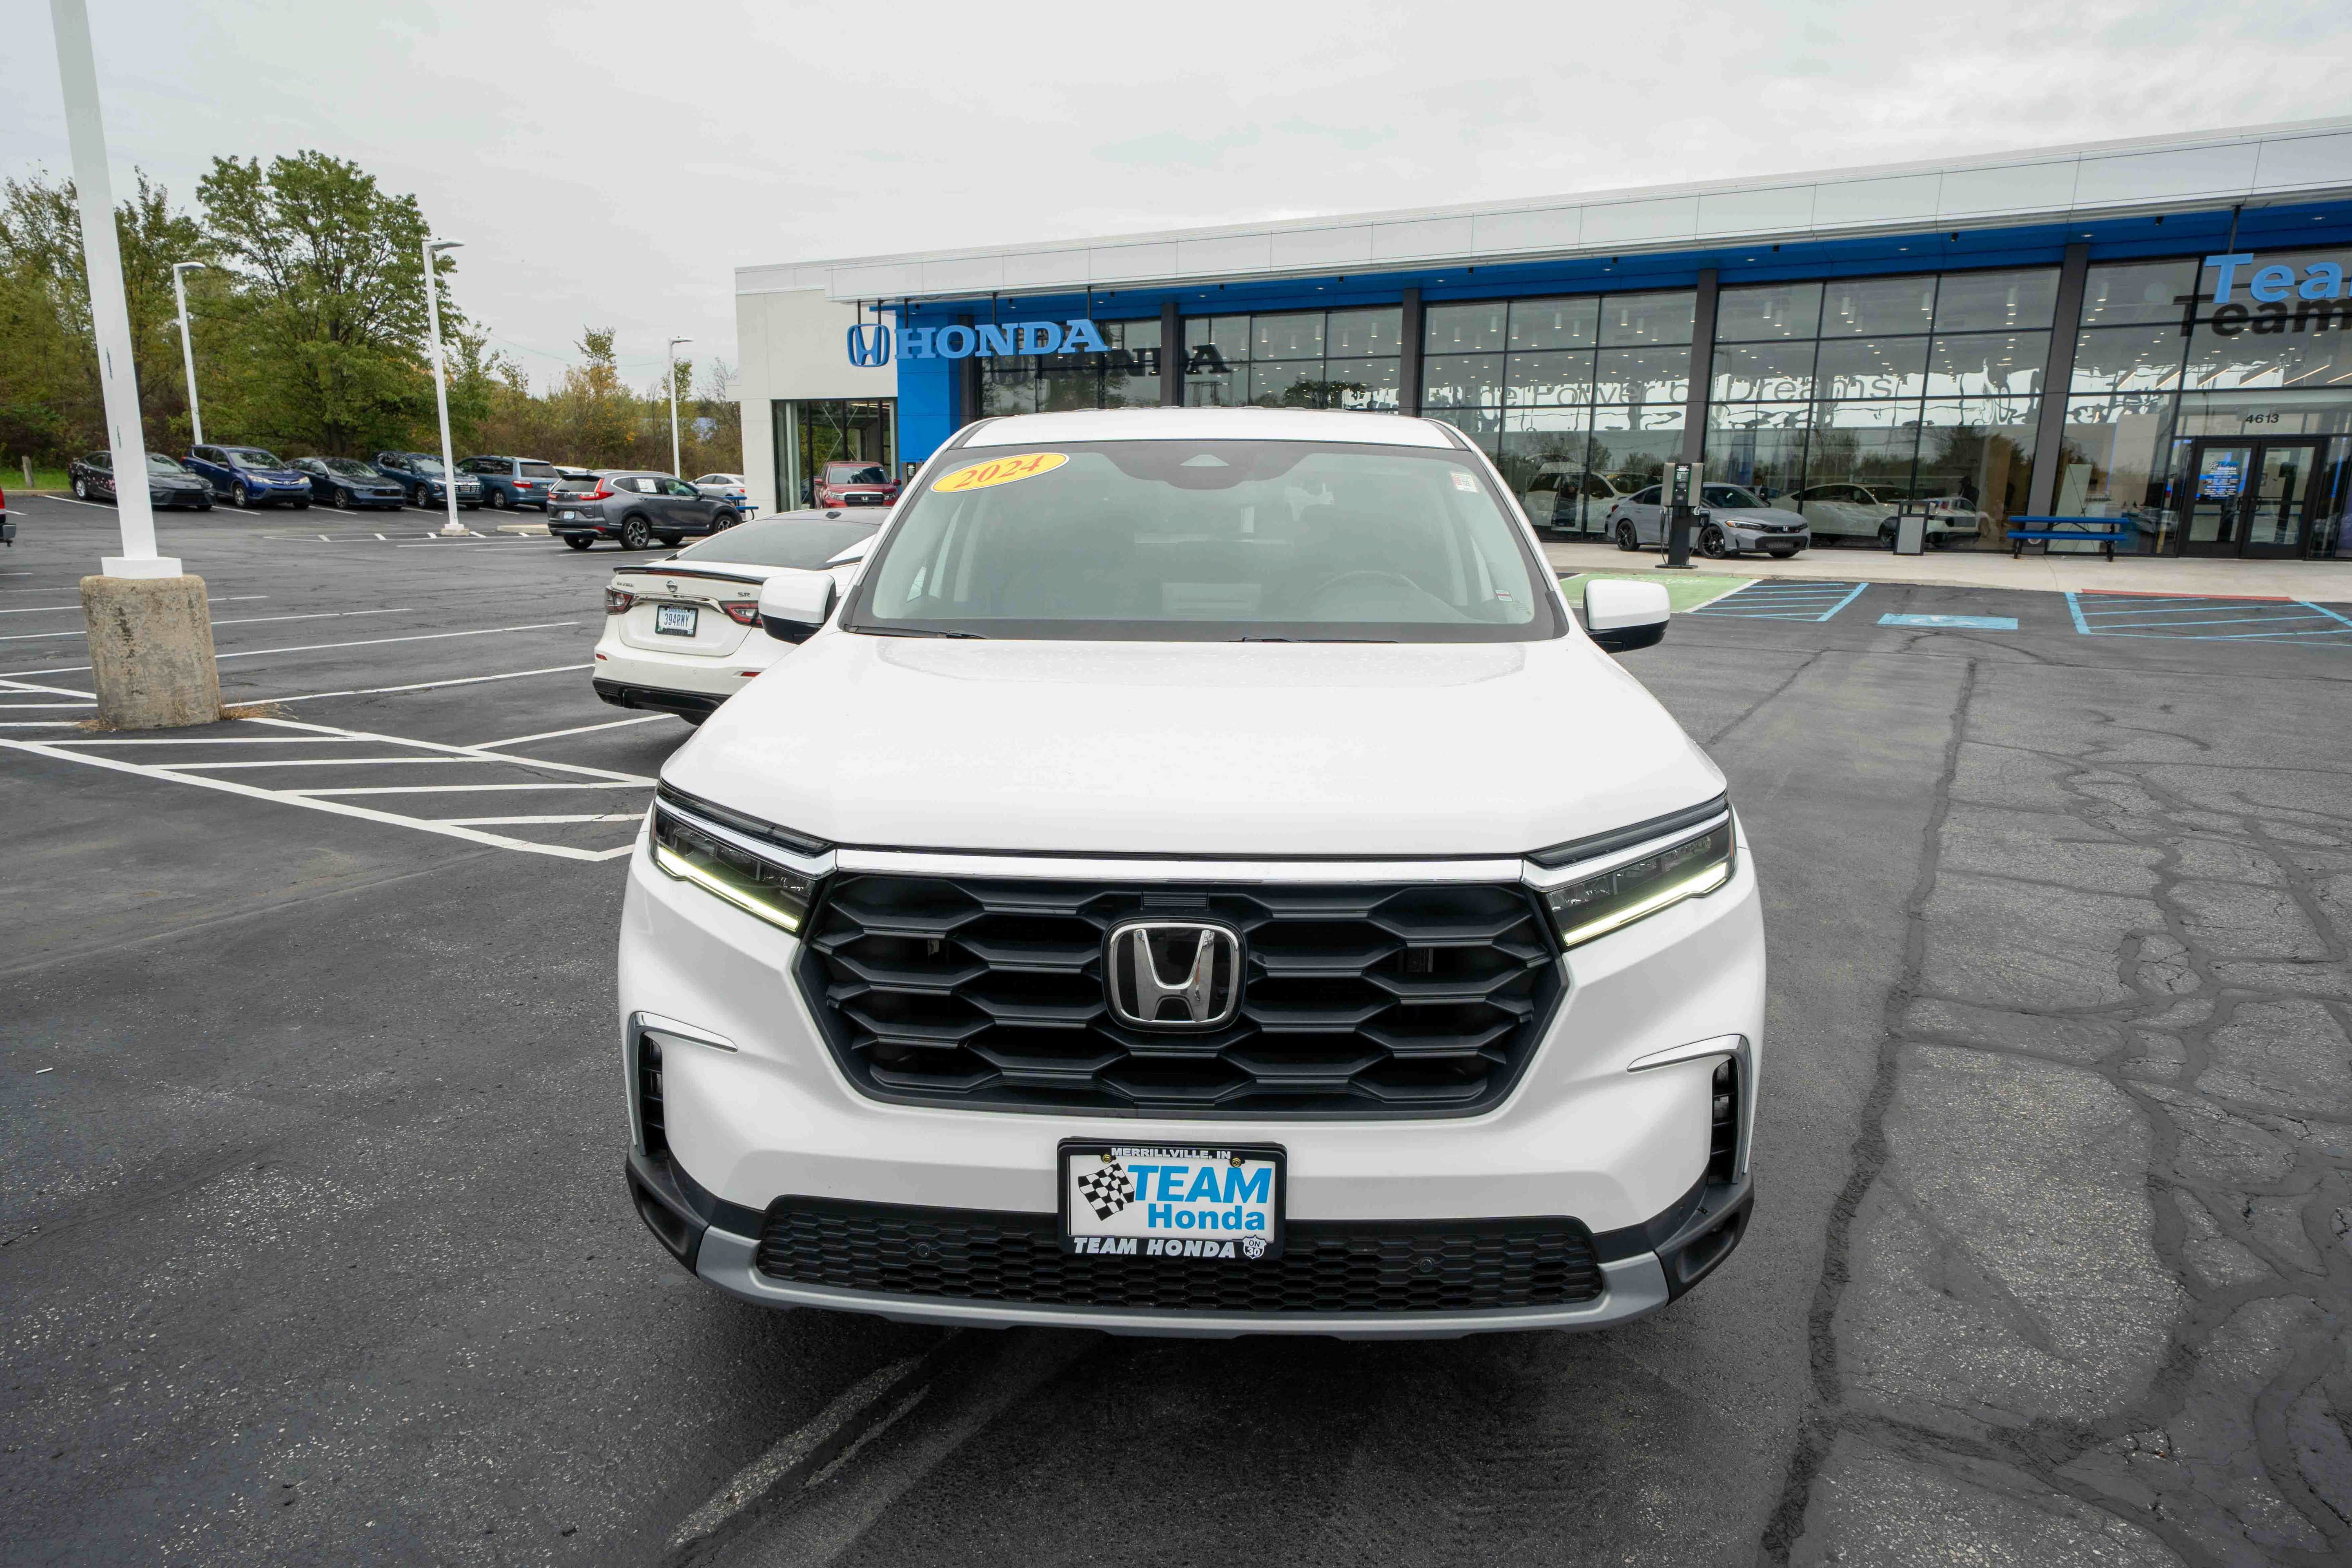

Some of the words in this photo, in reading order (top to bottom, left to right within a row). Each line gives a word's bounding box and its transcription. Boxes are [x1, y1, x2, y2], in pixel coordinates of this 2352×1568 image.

[2204, 253, 2352, 304] Tea
[895, 319, 1111, 359] HONDA
[2245, 414, 2279, 423] 4613
[954, 455, 1045, 489] 2024
[664, 613, 689, 627] 394RMY
[1111, 1148, 1212, 1160] MERRILLVILLE,
[1217, 1151, 1231, 1159] IN
[1128, 1165, 1272, 1203] TEAM
[1148, 1203, 1265, 1230] Honda
[1074, 1238, 1137, 1255] TEAM
[1146, 1239, 1236, 1258] HONDA
[1247, 1247, 1261, 1256] 30
